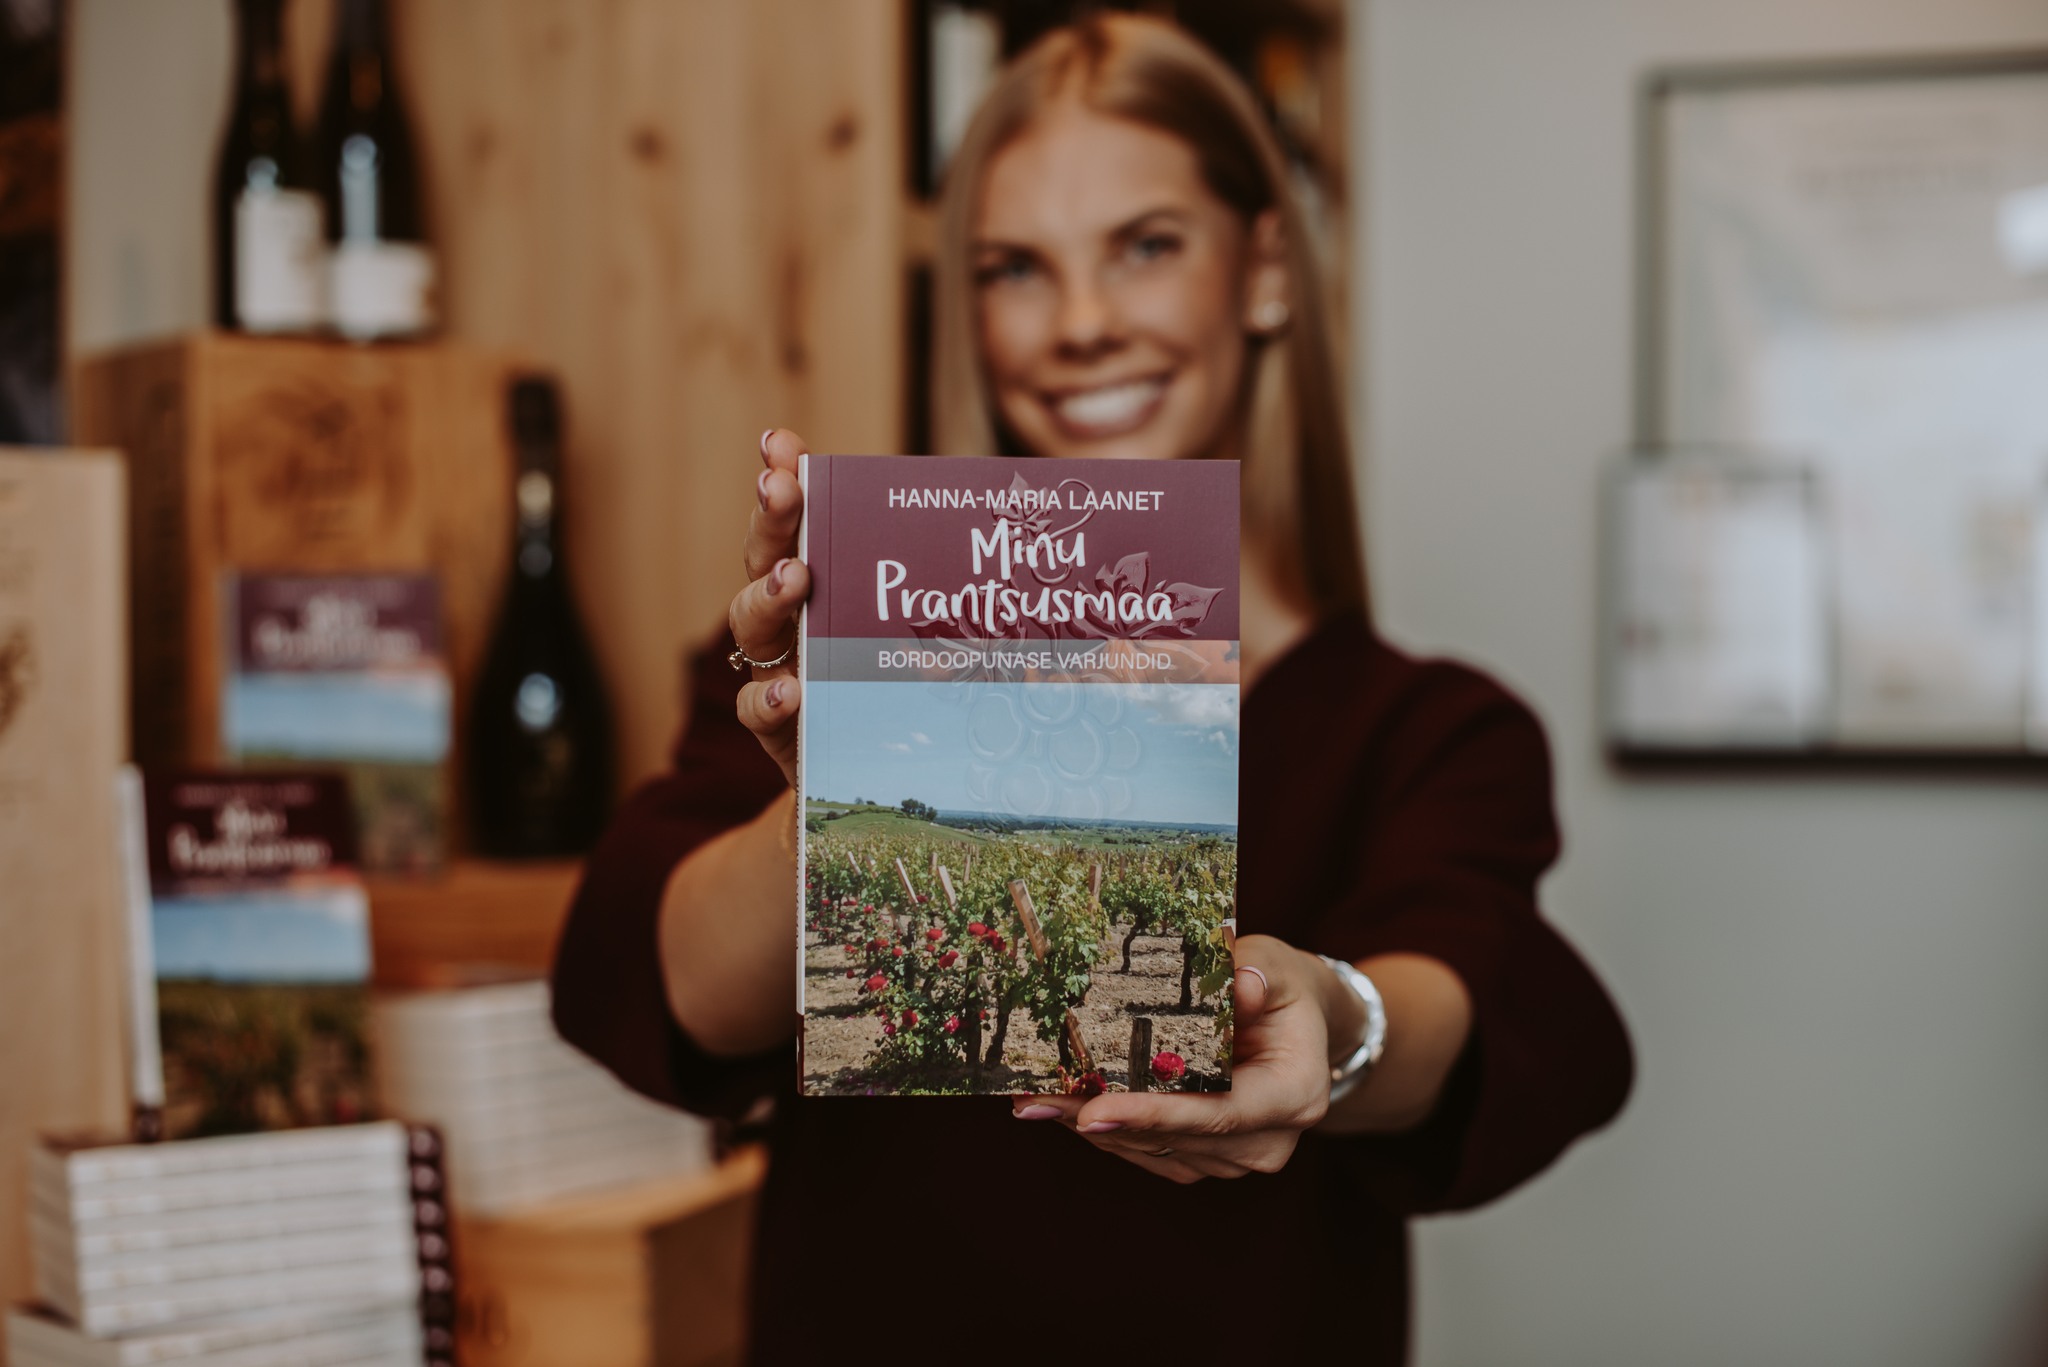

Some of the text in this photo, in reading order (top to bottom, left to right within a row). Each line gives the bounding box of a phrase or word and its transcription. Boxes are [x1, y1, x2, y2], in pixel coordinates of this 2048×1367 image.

[888, 488, 1165, 511] HANNA-MARIA LAANET
[970, 517, 1086, 580] Minu
[876, 559, 1173, 632] Prantsusmaa
[877, 650, 1171, 670] BORDOOPUNASE VARJUNDID
